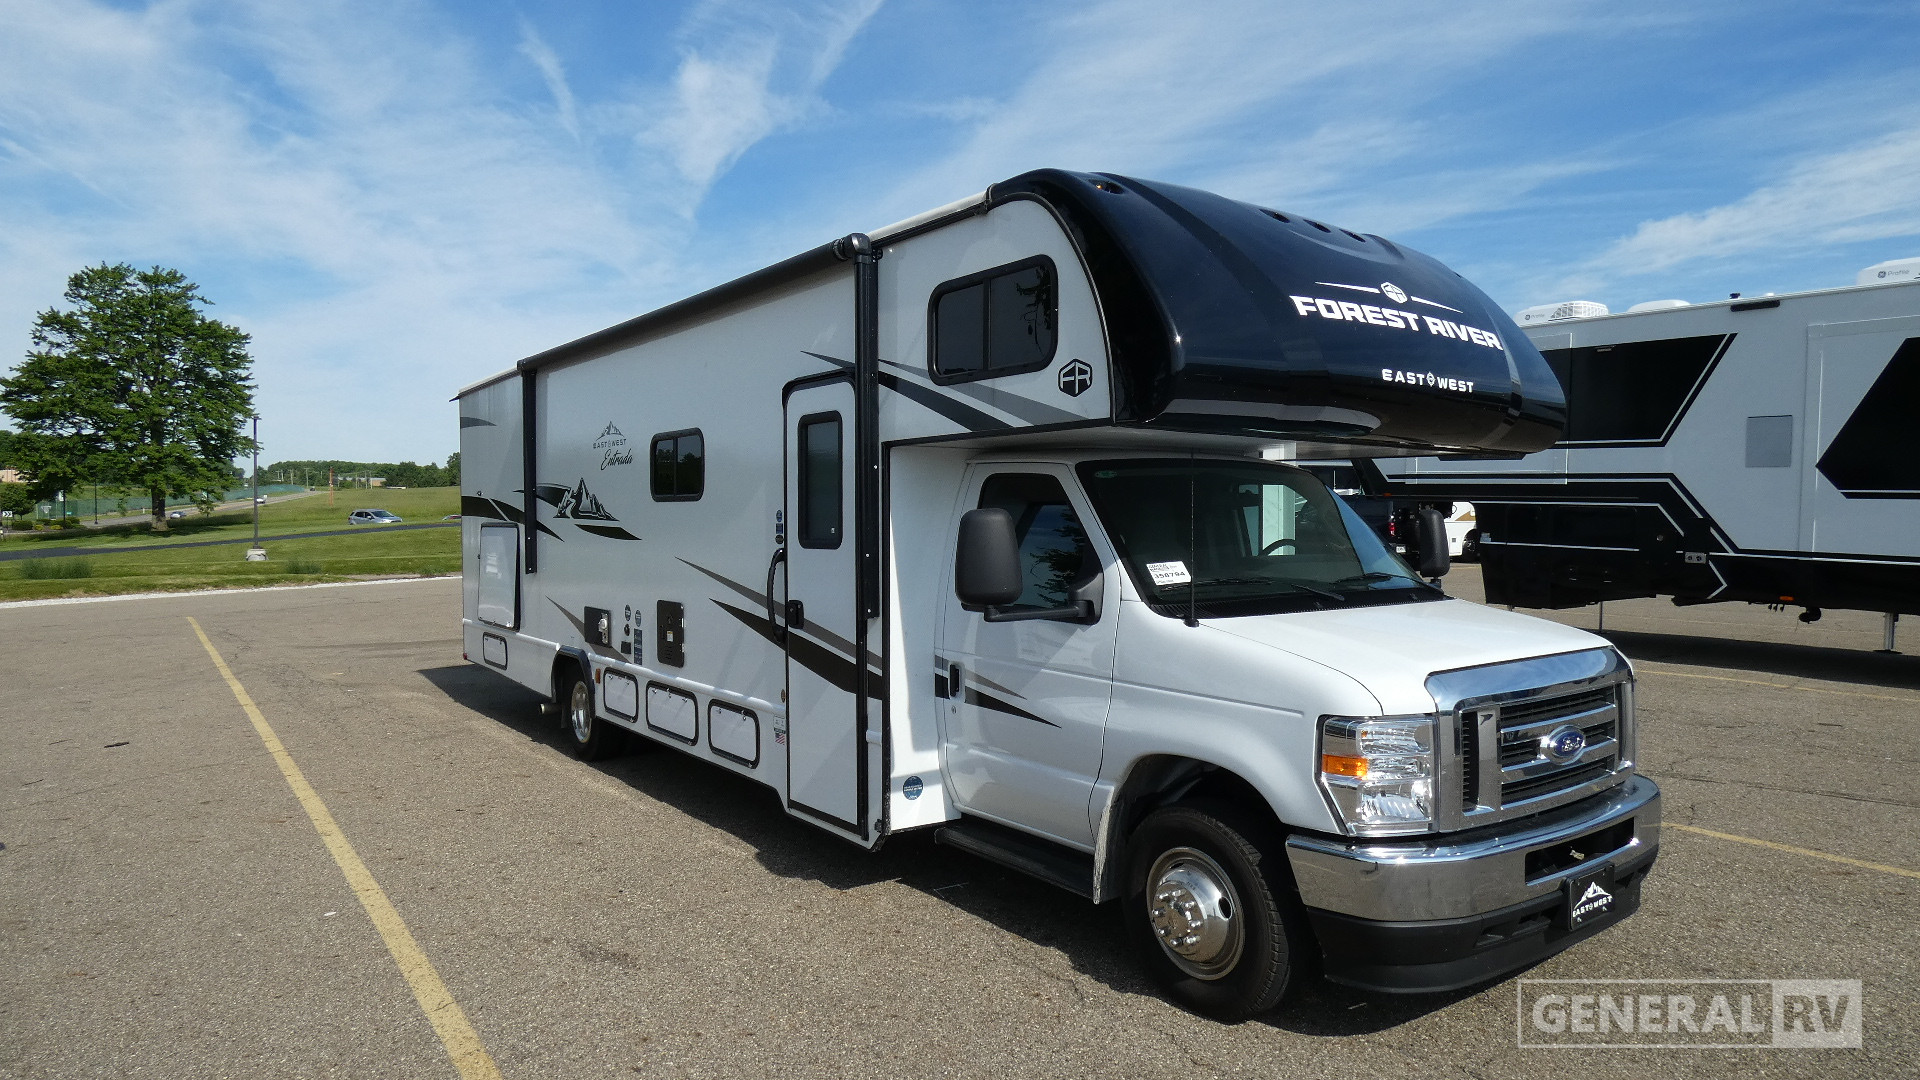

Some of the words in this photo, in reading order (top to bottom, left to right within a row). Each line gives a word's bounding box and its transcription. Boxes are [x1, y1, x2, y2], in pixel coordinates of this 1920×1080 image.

[1289, 295, 1420, 332] FOREST
[1422, 315, 1504, 351] RIVER
[1381, 368, 1425, 386] EAST
[1437, 376, 1474, 393] WEST
[592, 441, 608, 449] EAST
[1572, 904, 1590, 918] EAST
[1593, 895, 1613, 908] WEST
